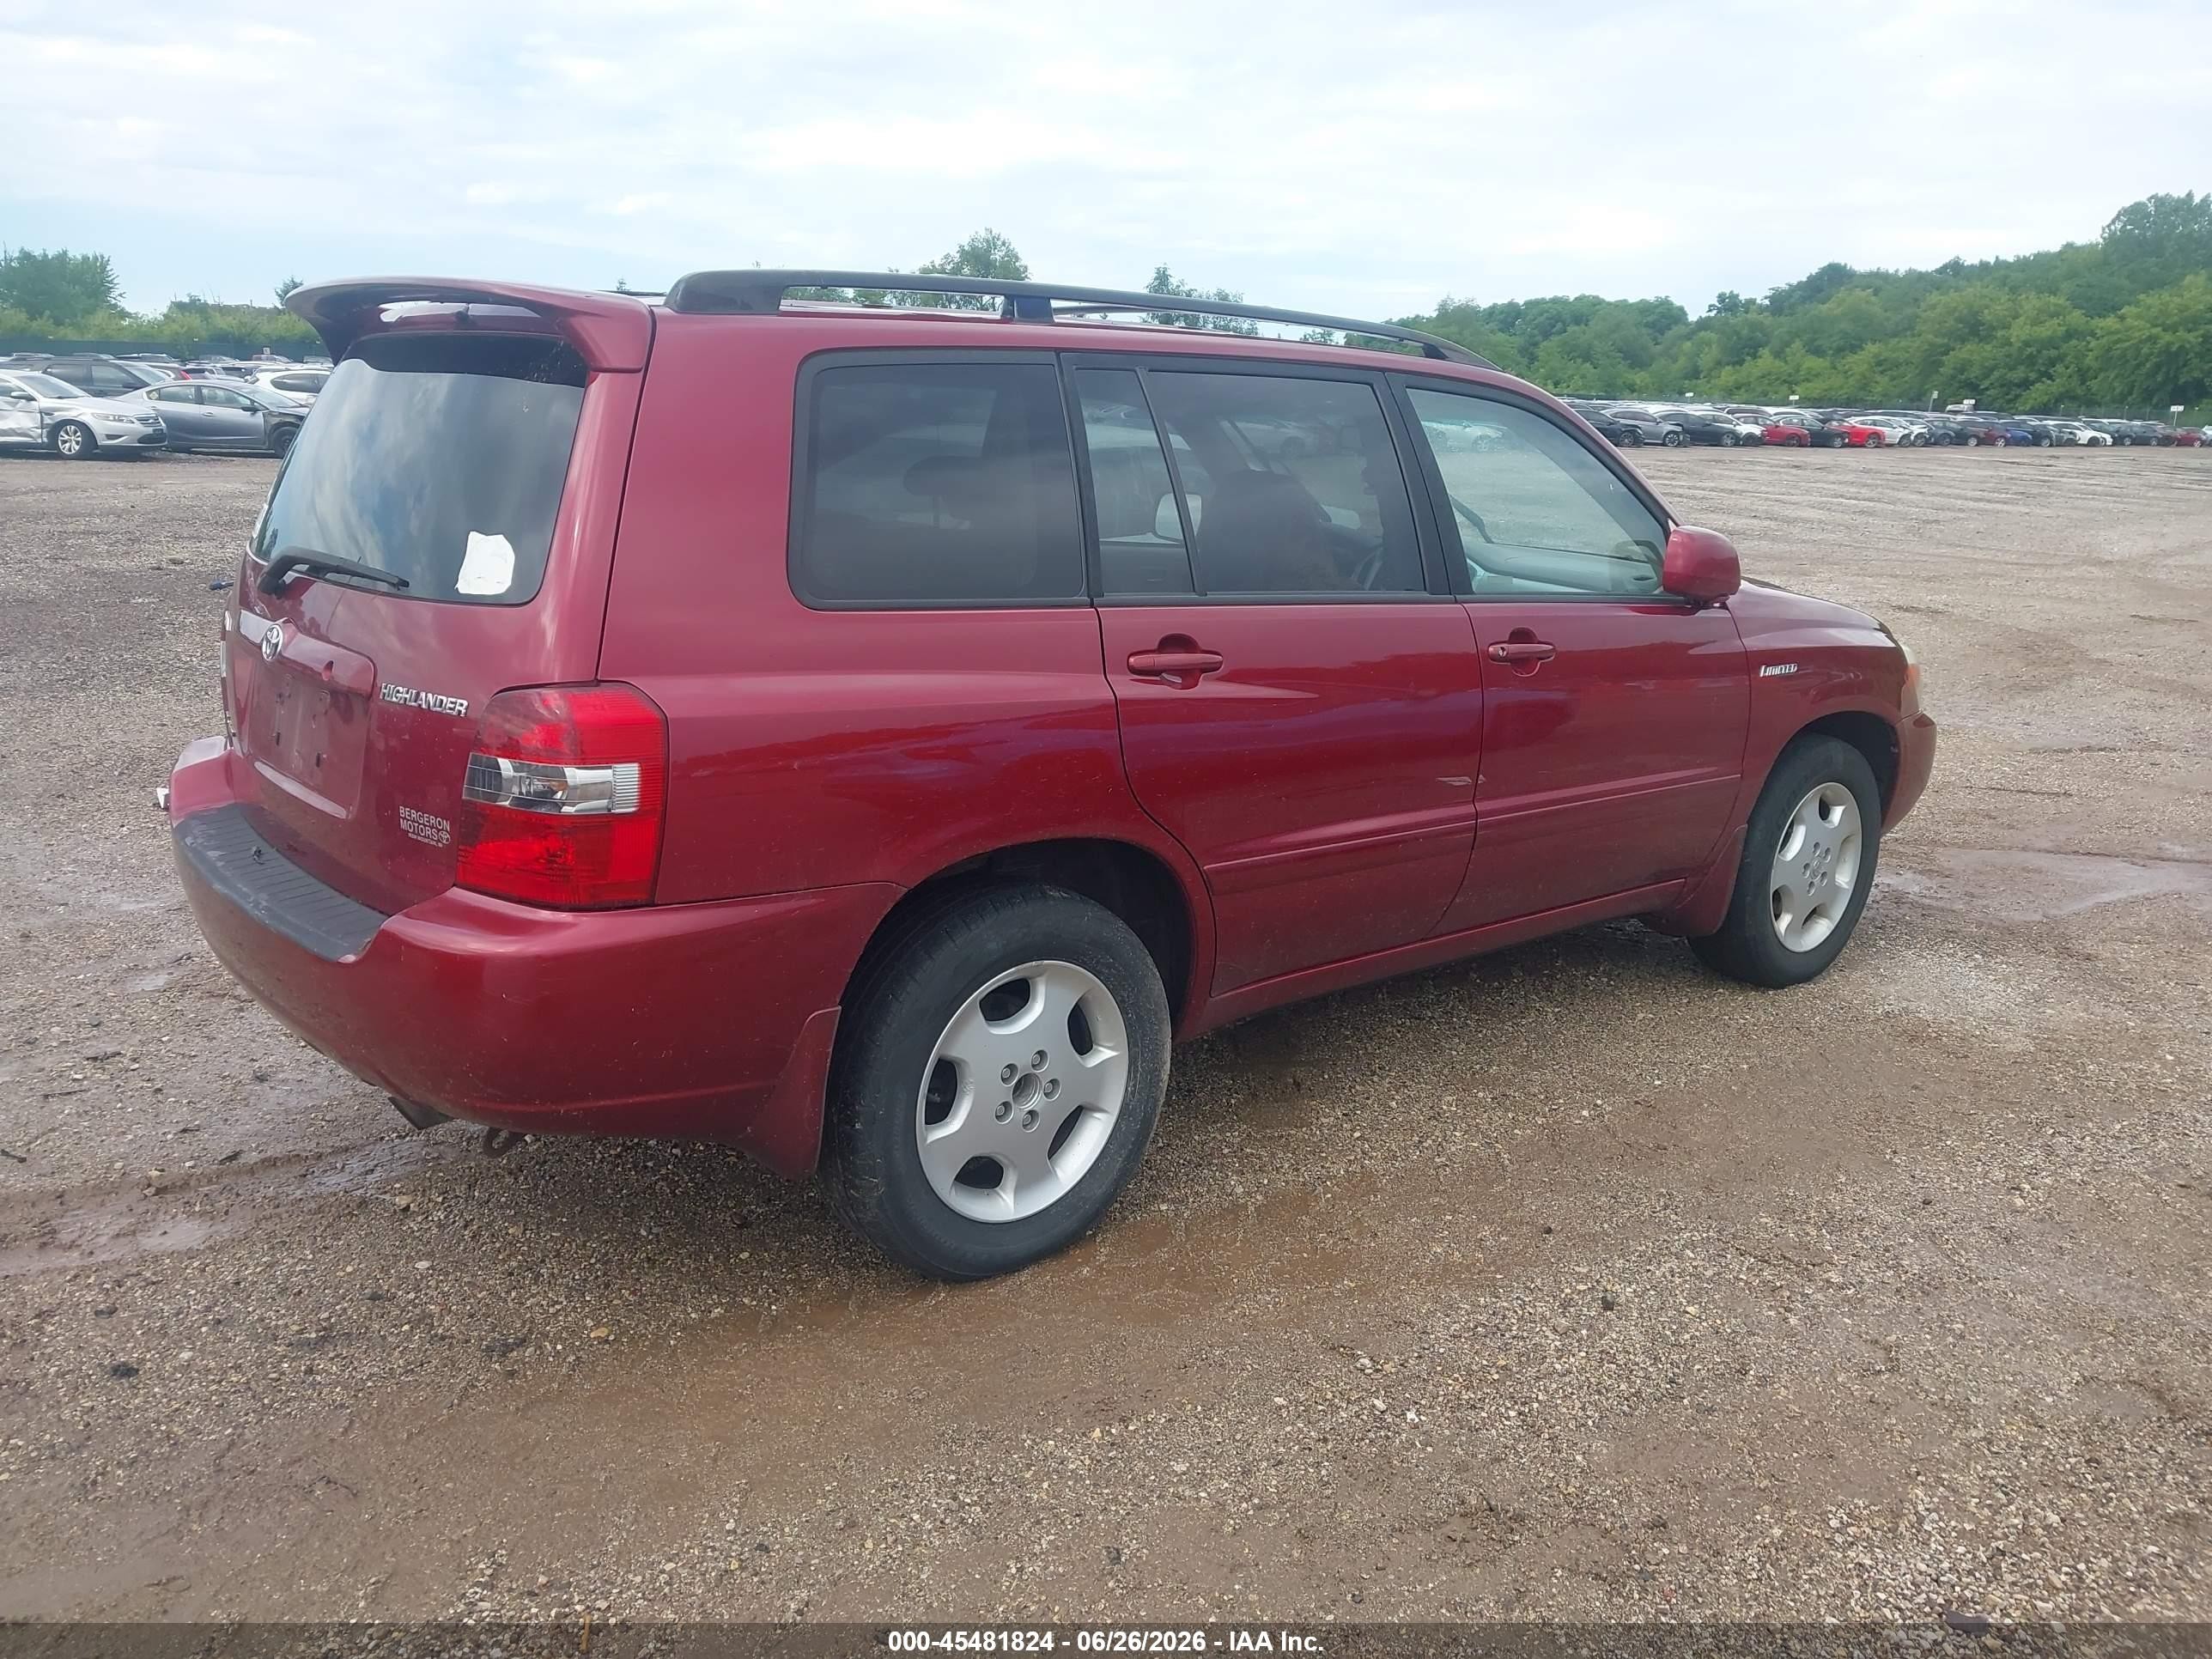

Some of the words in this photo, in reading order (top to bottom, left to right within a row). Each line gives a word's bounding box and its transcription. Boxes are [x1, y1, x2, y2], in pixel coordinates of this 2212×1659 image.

[380, 683, 469, 717] HIGHLANDER
[398, 805, 450, 832] BERGERON
[399, 817, 438, 841] MOTORS
